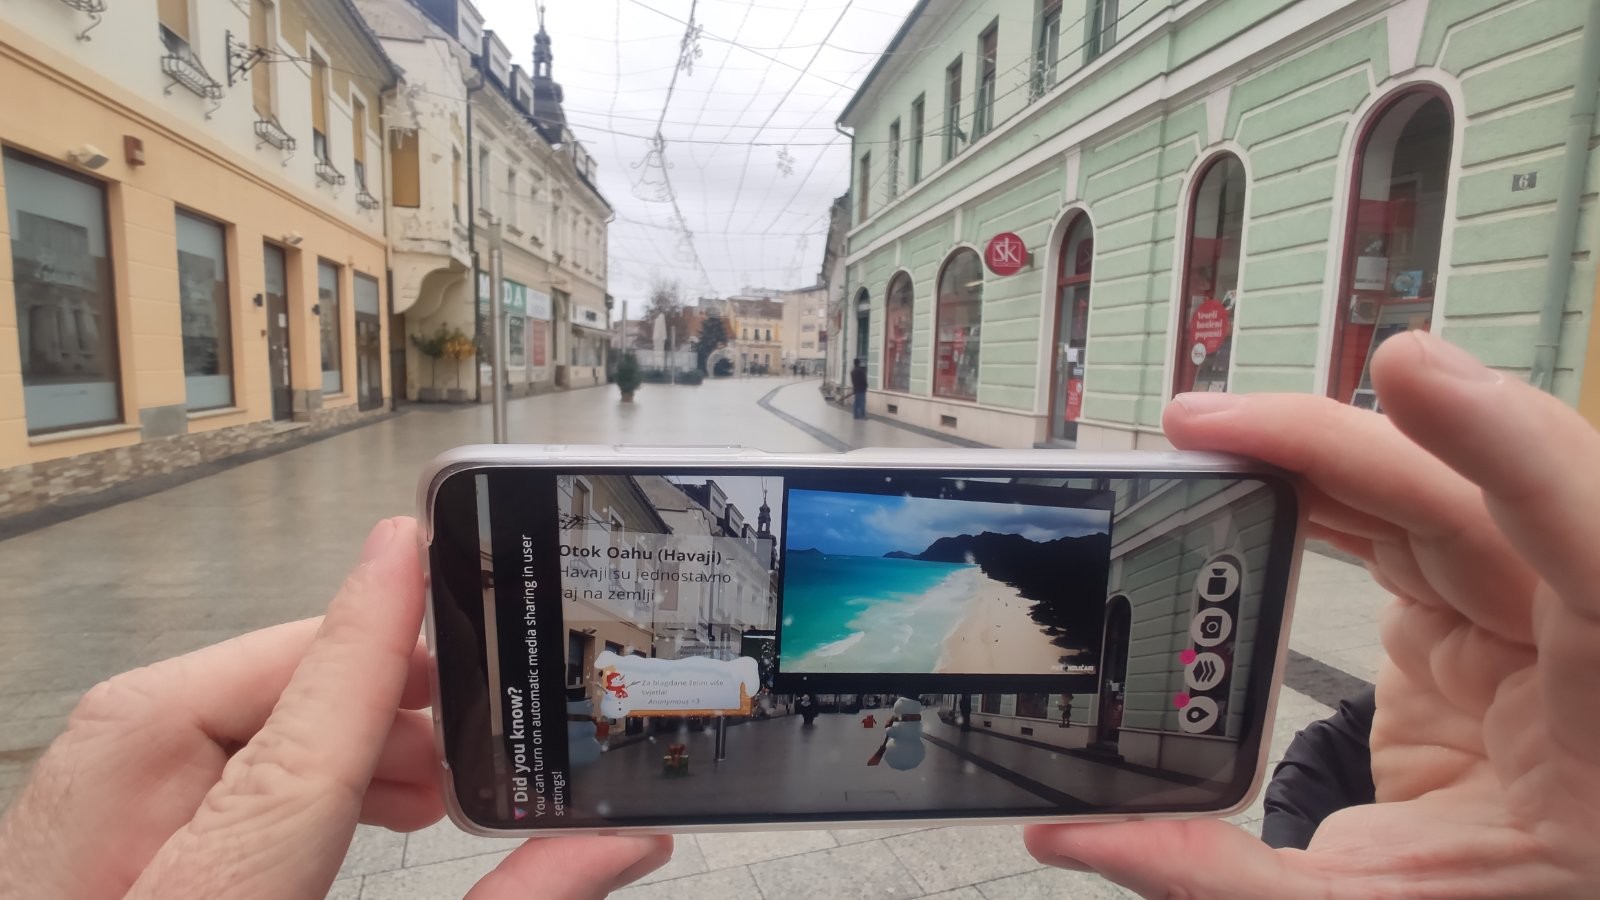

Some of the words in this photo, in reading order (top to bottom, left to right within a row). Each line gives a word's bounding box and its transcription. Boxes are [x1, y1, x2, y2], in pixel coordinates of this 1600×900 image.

[1519, 174, 1529, 190] 6
[522, 534, 533, 562] user
[560, 544, 602, 558] Otok
[607, 546, 653, 560] Oahu
[658, 549, 722, 565] (Havaji)
[522, 566, 534, 577] in
[613, 569, 631, 580] su
[635, 568, 732, 583] jednostavno
[523, 580, 538, 625] sharing
[561, 589, 578, 602] aj
[584, 589, 603, 600] na
[608, 589, 655, 604] zemlji
[525, 629, 538, 666] media
[528, 669, 542, 726] automatic
[507, 687, 525, 739] know?
[533, 729, 542, 744] on
[514, 743, 531, 773] you
[534, 747, 544, 771] turn
[512, 777, 529, 802] Did
[535, 774, 545, 793] can
[552, 771, 566, 816] settings!
[535, 796, 546, 817] You
